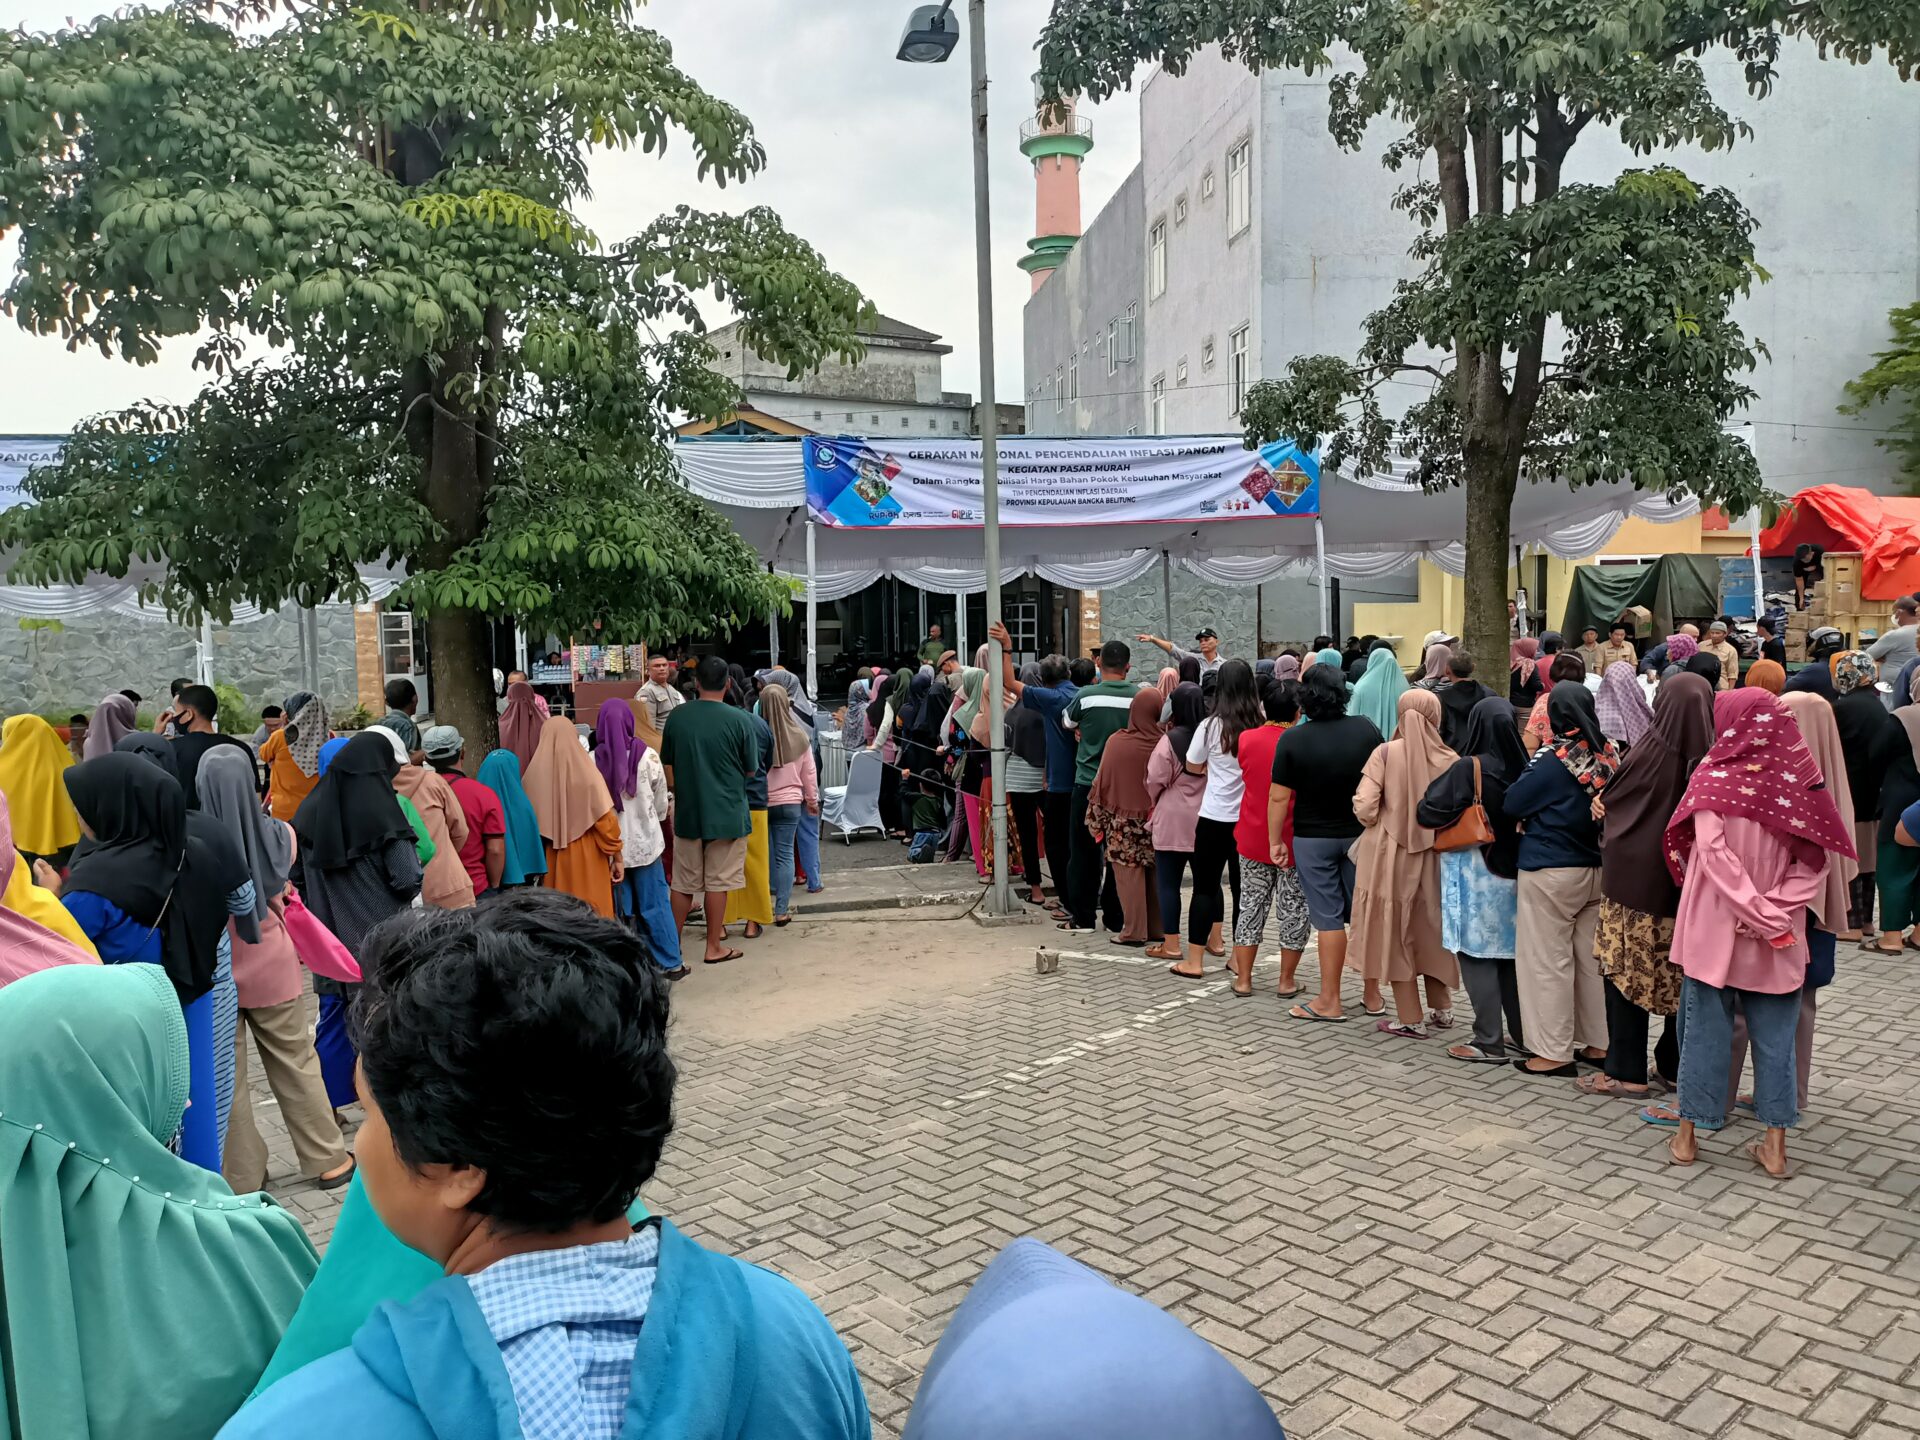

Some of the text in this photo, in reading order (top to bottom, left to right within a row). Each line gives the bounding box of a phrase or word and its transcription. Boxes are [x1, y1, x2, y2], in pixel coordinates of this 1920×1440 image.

[908, 450, 967, 460] GERAKAN
[1035, 449, 1127, 459] PENGENDALIAN
[1130, 447, 1175, 457] INFLASI
[1178, 445, 1226, 456] PANGAN
[1008, 463, 1131, 474] KEGIATAN PASAR MURAH
[912, 471, 1222, 486] Dalam Rangka bilisasi Harga Bahan Pokok Kebutuhan Masyarakat
[1012, 487, 1128, 497] TIM PENGENDALIAN INFLASI DAERAH
[1006, 499, 1037, 507] PROVINSI
[1038, 498, 1077, 506] KEPULAUAN
[1105, 496, 1136, 504] BELITUNG
